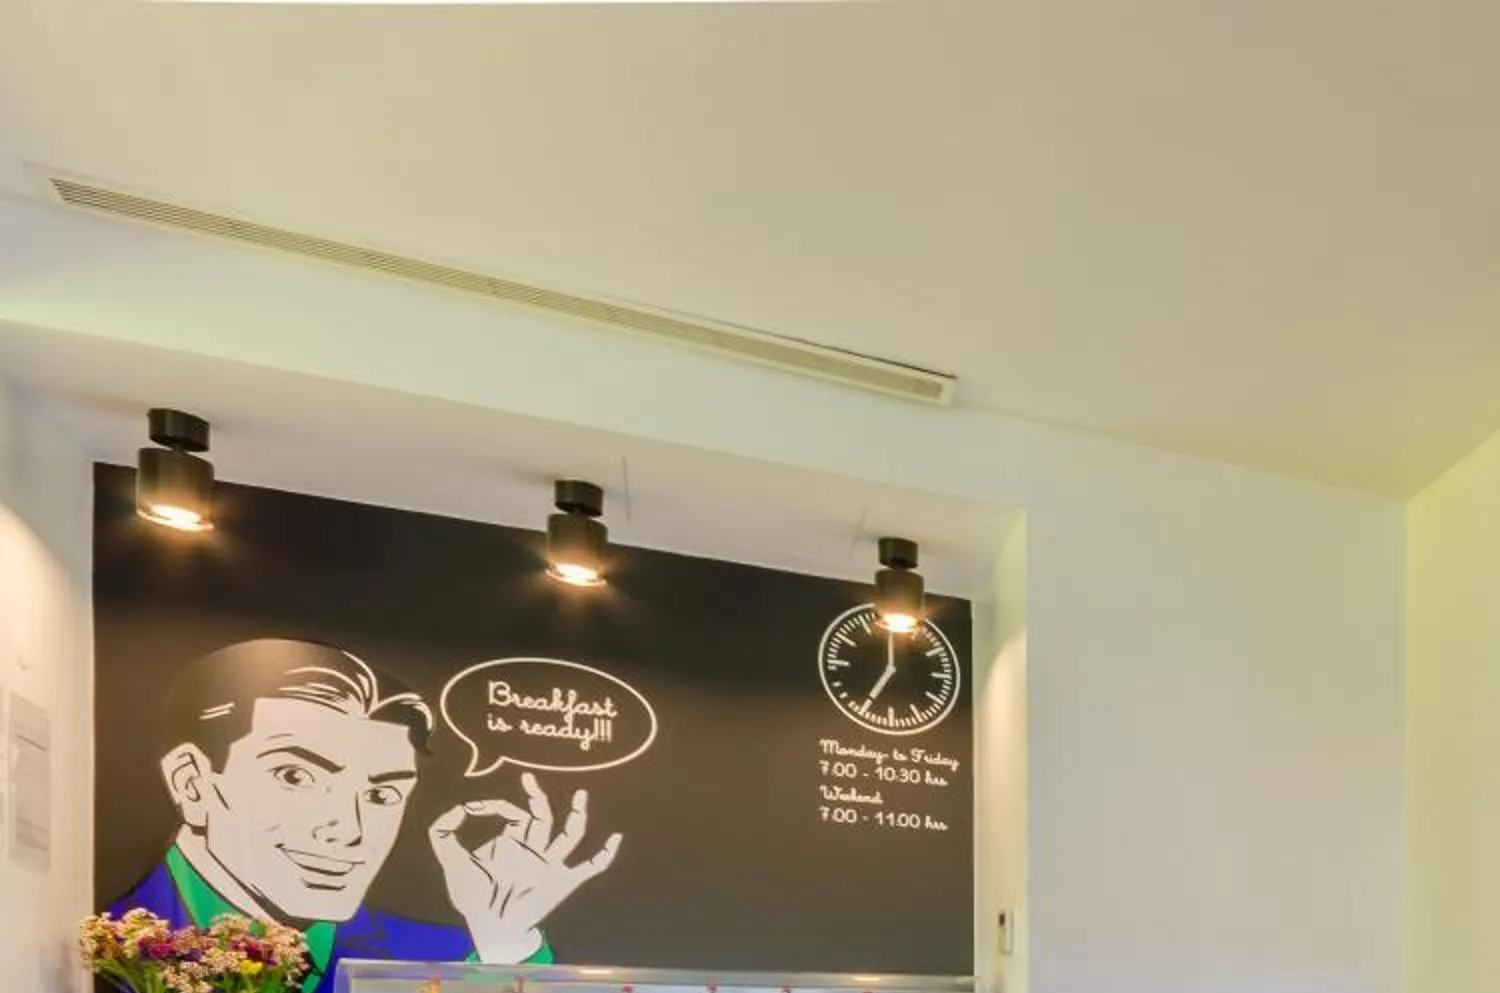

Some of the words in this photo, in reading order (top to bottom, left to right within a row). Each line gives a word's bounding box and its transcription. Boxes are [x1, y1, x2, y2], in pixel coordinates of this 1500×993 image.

[487, 681, 619, 724] Breakfast
[486, 713, 513, 732] is
[519, 717, 613, 751] ready!!!
[819, 739, 889, 764] Monday
[893, 749, 907, 761] to
[910, 748, 960, 772] Friday
